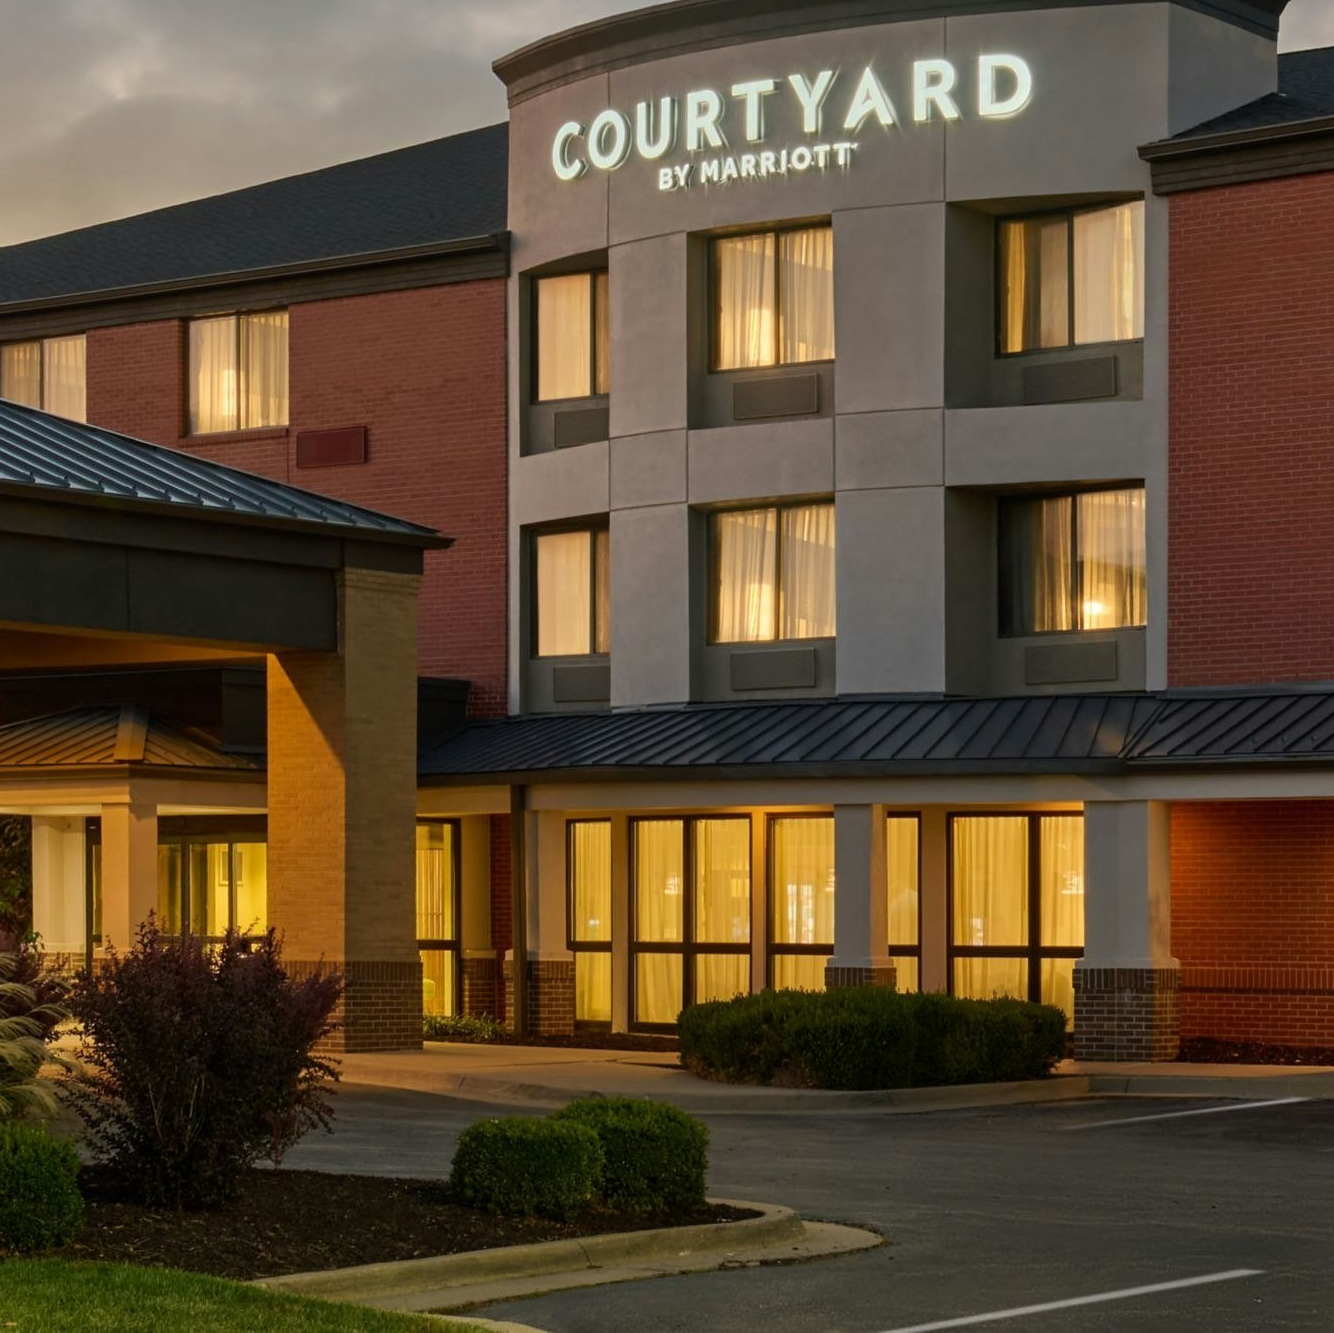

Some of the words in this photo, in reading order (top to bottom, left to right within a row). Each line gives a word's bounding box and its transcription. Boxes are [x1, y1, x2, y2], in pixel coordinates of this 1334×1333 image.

[552, 53, 1033, 180] COURTYARD
[658, 164, 691, 190] BY
[700, 141, 853, 184] MARRIOTT
